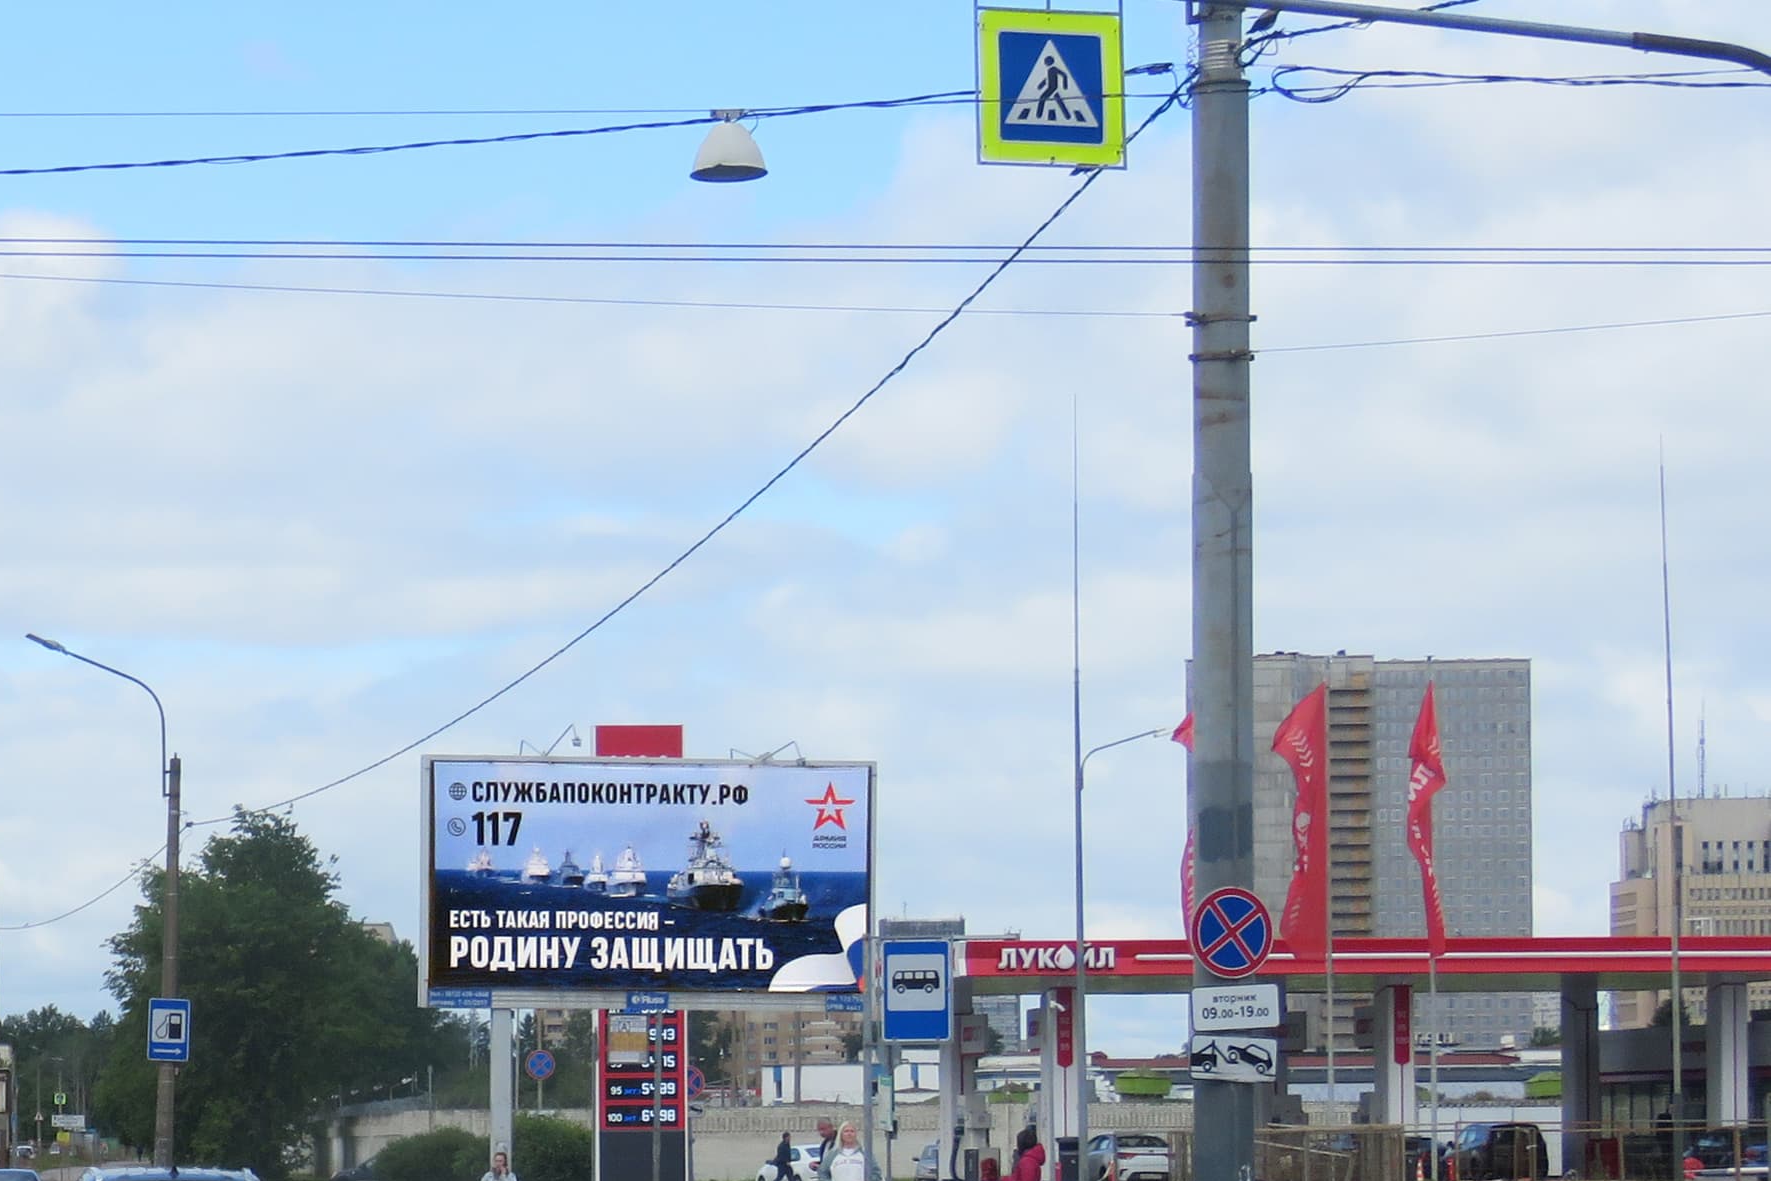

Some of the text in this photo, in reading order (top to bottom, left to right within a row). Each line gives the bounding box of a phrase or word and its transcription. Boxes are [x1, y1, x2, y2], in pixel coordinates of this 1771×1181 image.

[471, 781, 749, 805] СЛУЖБАПОКОНТРАКТУ.РФ
[471, 811, 523, 846] 117
[449, 910, 491, 929] ЕСТЬ
[496, 910, 550, 929] ТАКАЯ
[555, 911, 659, 930] ПРОФЕССИЯ
[449, 936, 774, 973] РОДИНУ ЗАЩИЩАТЬ
[1212, 994, 1257, 1004] вторник
[1202, 1005, 1270, 1020] 09.00-19.00
[610, 1086, 622, 1095] 95
[607, 1113, 622, 1122] 100
